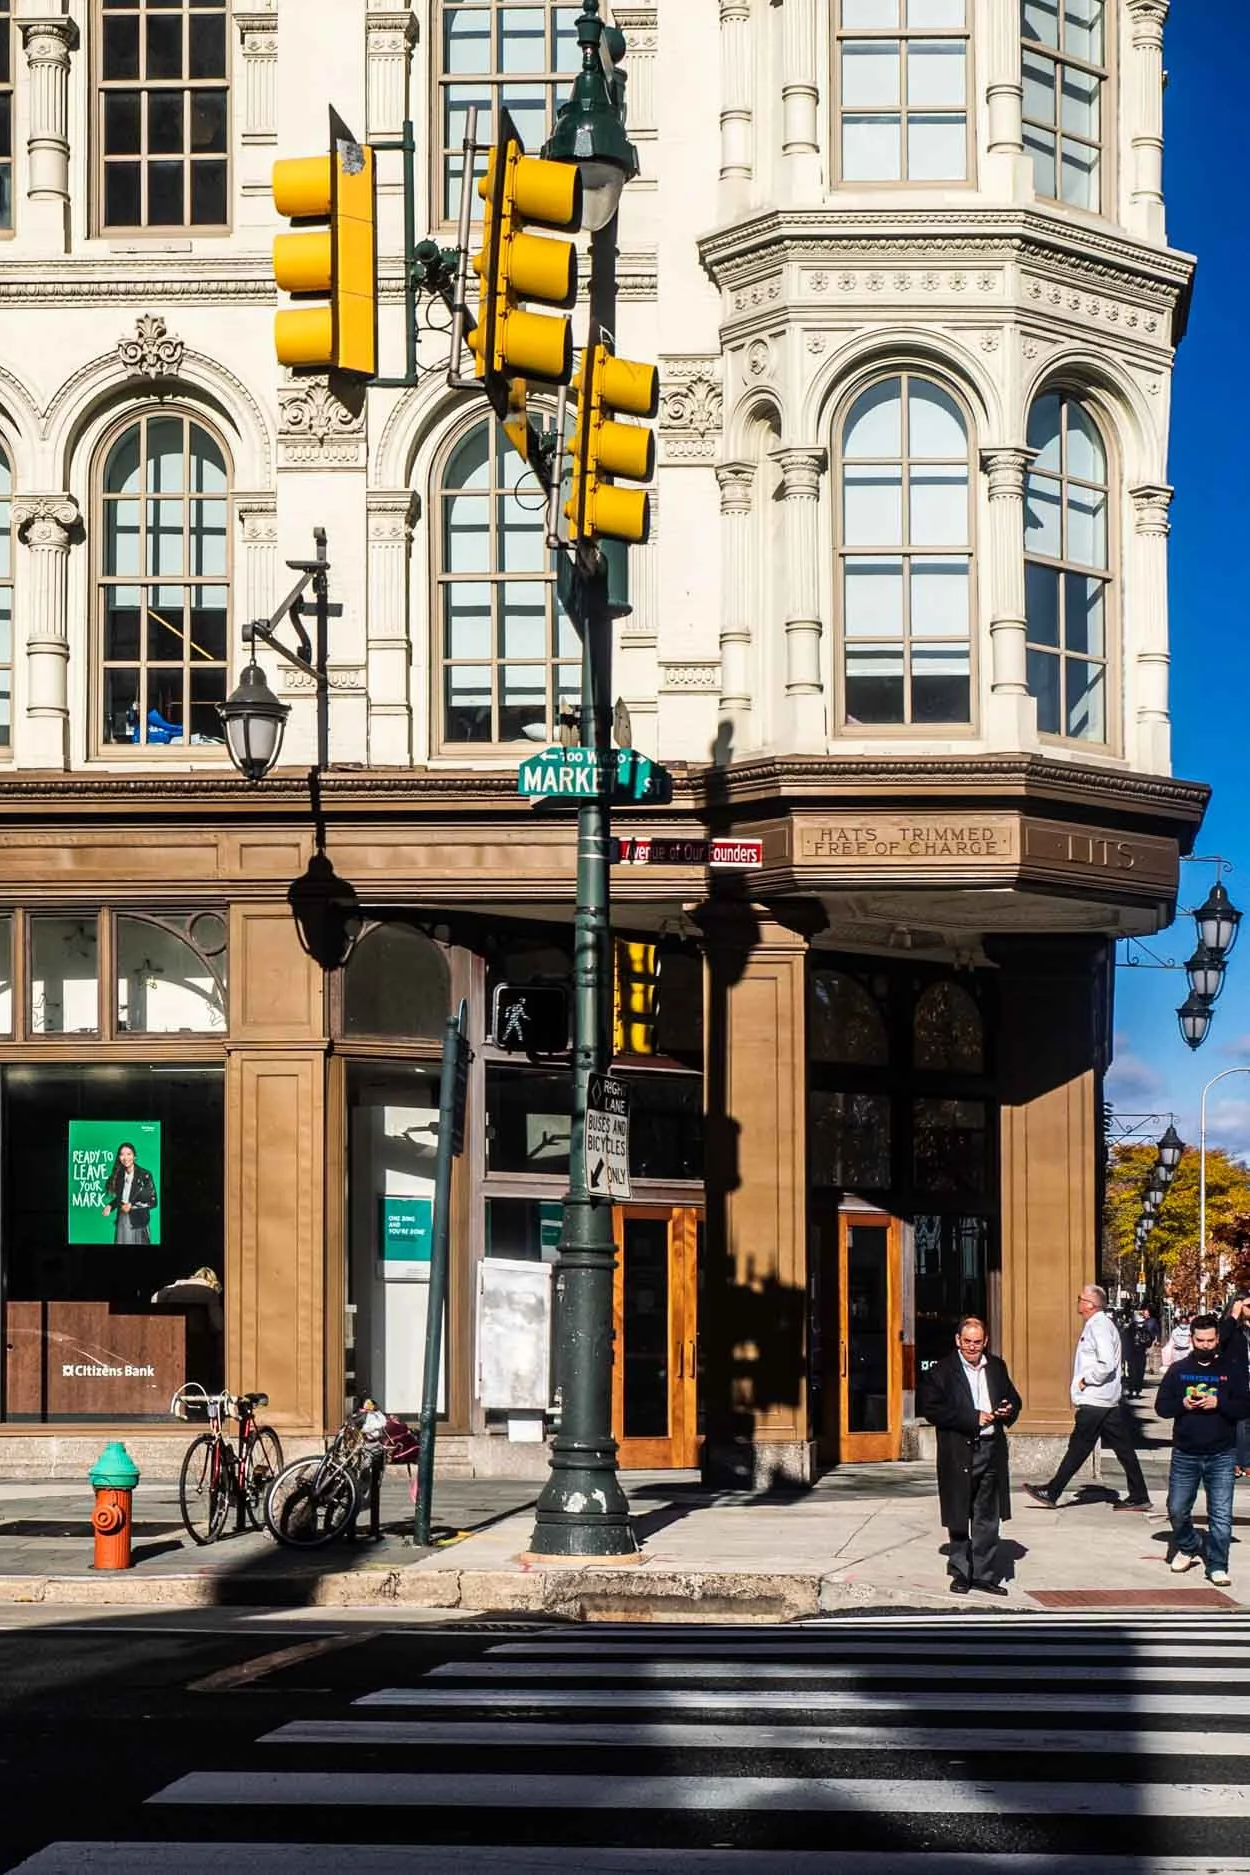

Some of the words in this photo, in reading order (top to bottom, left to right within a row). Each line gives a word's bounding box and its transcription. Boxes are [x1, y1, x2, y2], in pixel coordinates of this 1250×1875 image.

[524, 766, 619, 793] MARKET
[643, 778, 662, 795] ST
[820, 827, 878, 842] HATS
[900, 827, 995, 842] TRIMMED
[669, 843, 681, 860] of
[684, 843, 705, 861] Our
[710, 843, 758, 862] Founders
[814, 842, 868, 855] FREE
[874, 841, 900, 855] OF
[909, 841, 998, 855] CHARGE
[1067, 834, 1135, 870] LITS
[603, 1079, 628, 1097] RIGHT
[605, 1097, 626, 1114] LANE
[588, 1114, 611, 1133] BUSES
[613, 1119, 626, 1137] AND
[587, 1134, 626, 1156] BICYCLES
[72, 1150, 101, 1164] READY
[102, 1151, 114, 1161] TO
[74, 1164, 108, 1180] LEAVE
[607, 1166, 626, 1184] ONLY
[79, 1180, 102, 1192] YOUR
[72, 1192, 106, 1208] MARK
[75, 1365, 122, 1376] Citizens
[124, 1365, 154, 1376] Bank
